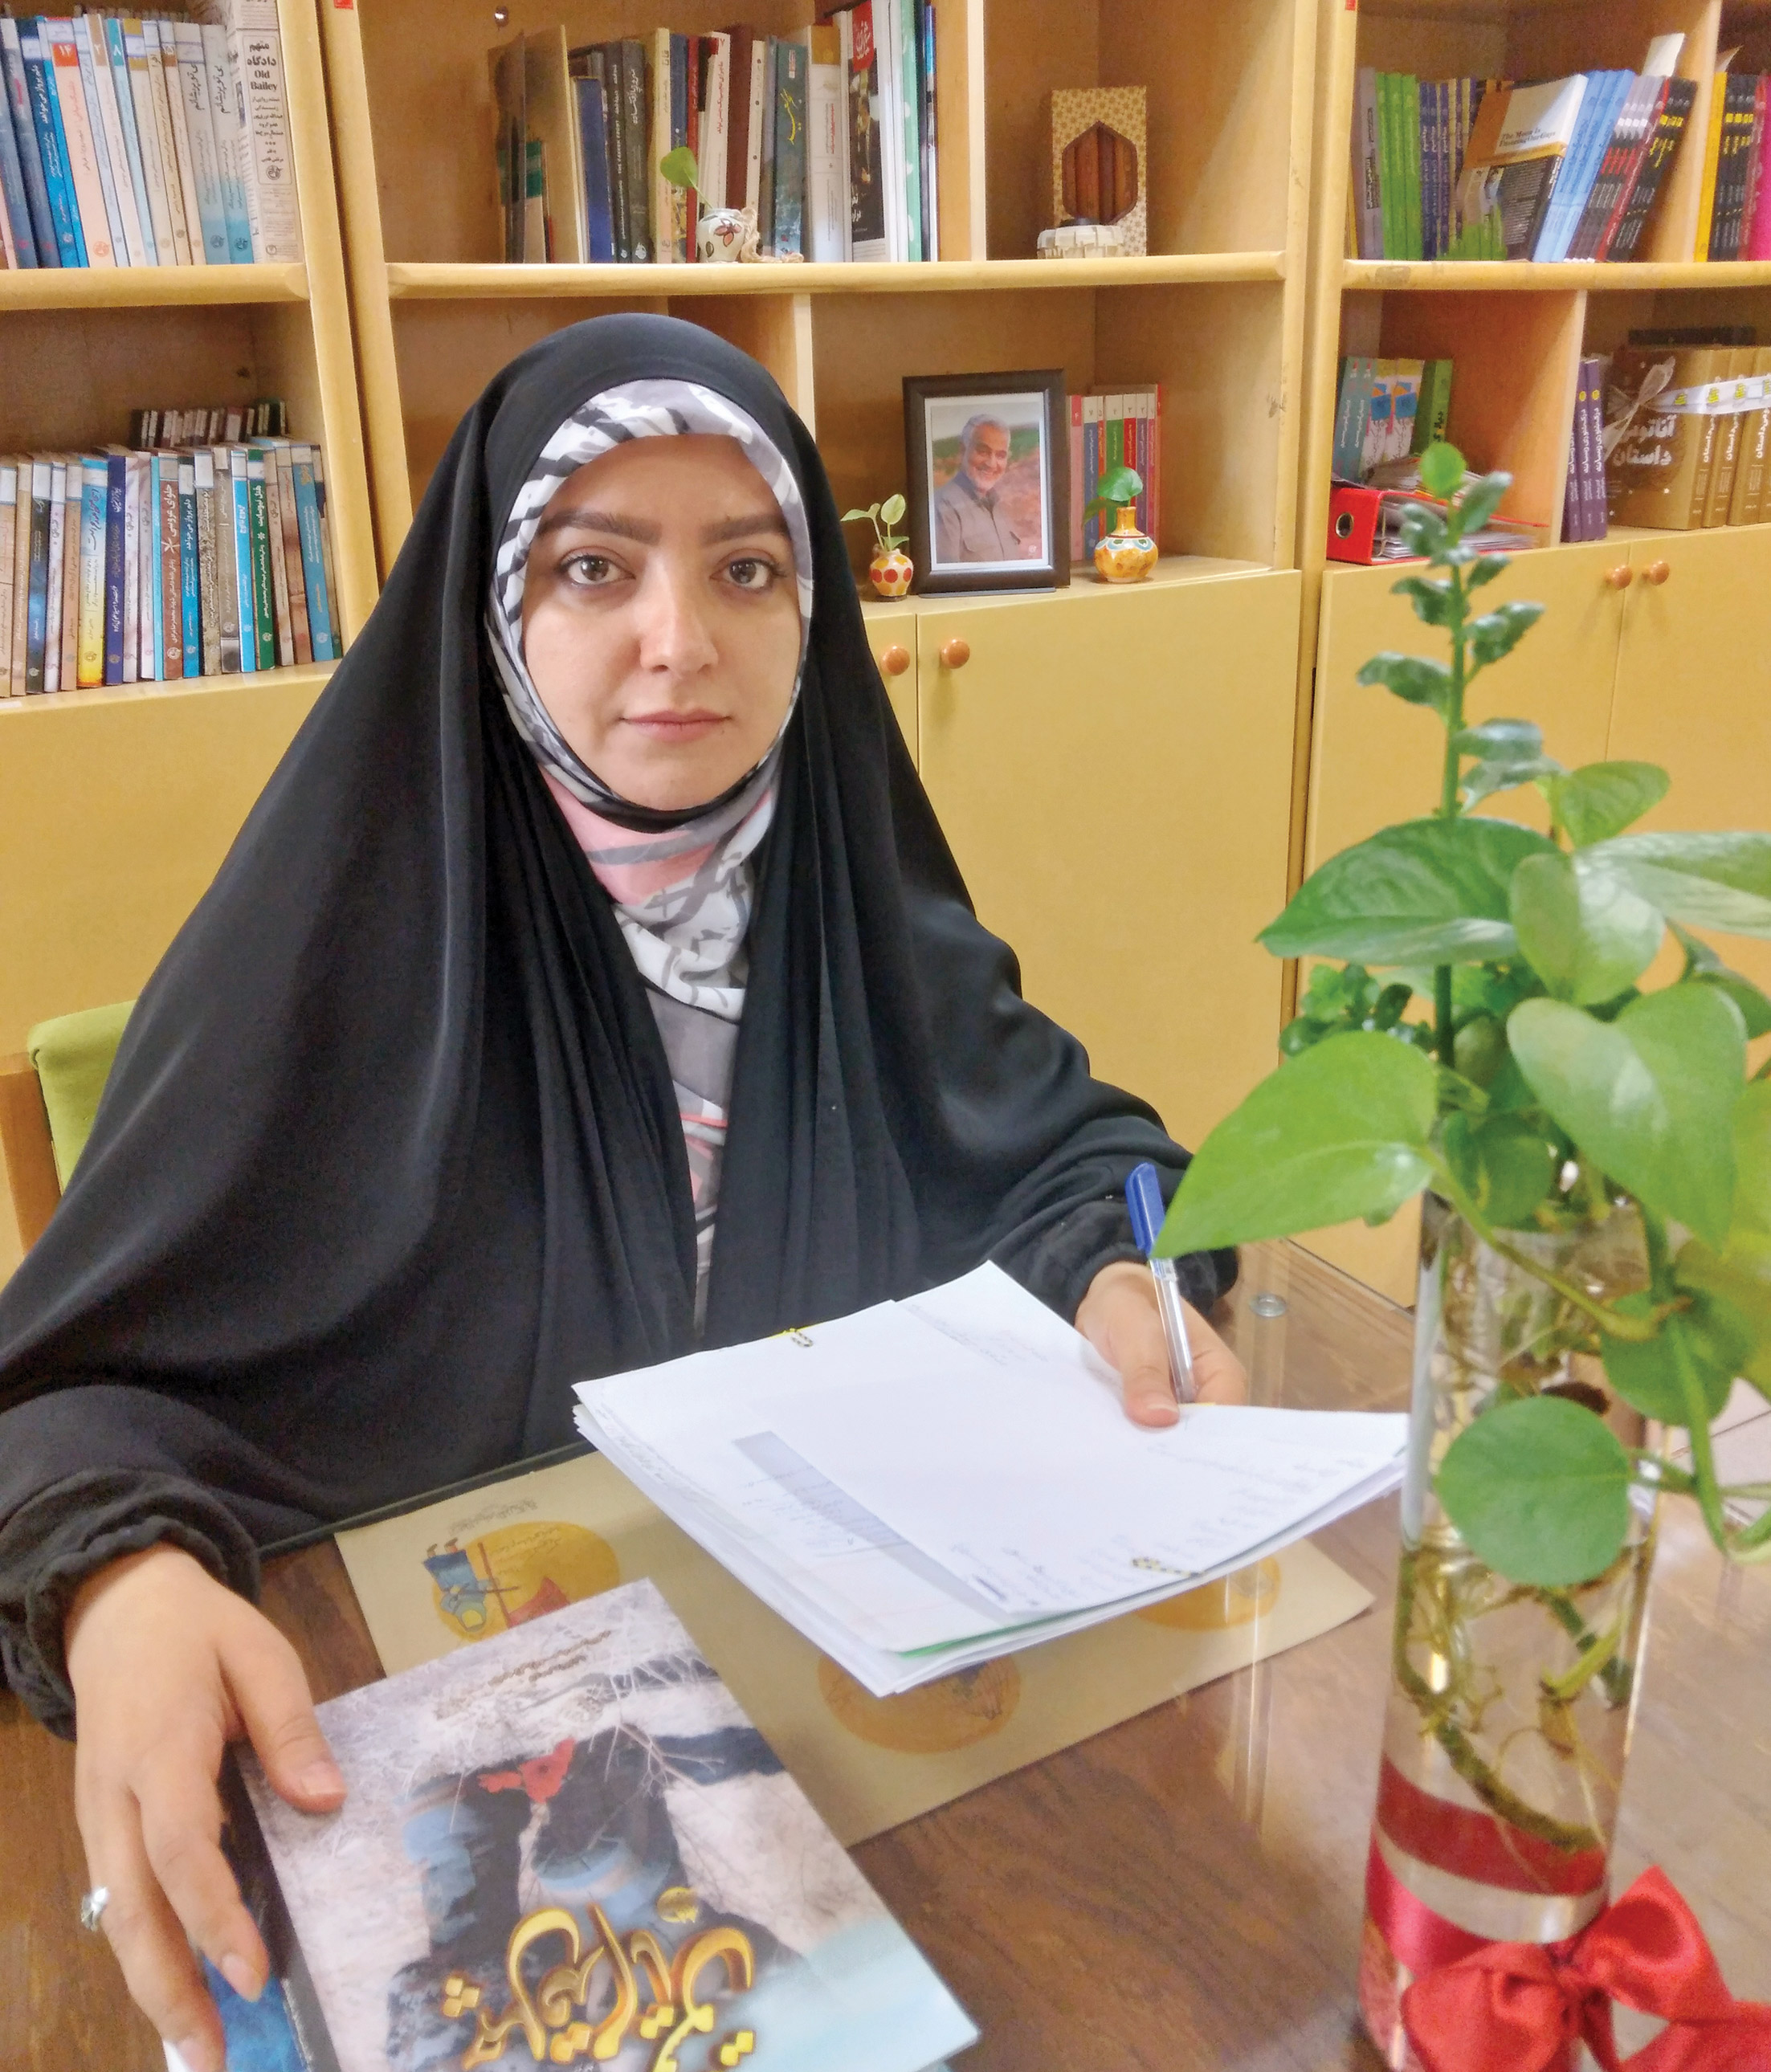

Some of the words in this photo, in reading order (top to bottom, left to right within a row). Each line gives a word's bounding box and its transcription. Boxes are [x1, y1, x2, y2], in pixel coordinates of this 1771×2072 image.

[250, 42, 270, 53] متهم
[247, 55, 276, 66] دادگاه
[255, 70, 270, 79] Old
[251, 81, 277, 92] Bailey
[214, 84, 231, 114] پریشانم
[1702, 430, 1712, 463] داستان
[1725, 427, 1736, 462] داستان
[1755, 425, 1767, 459] داستان
[1612, 444, 1672, 467] داستان
[164, 484, 176, 510] حلوای
[183, 499, 193, 510] دلم
[166, 510, 177, 537] عروسی
[184, 508, 194, 523] پرواز
